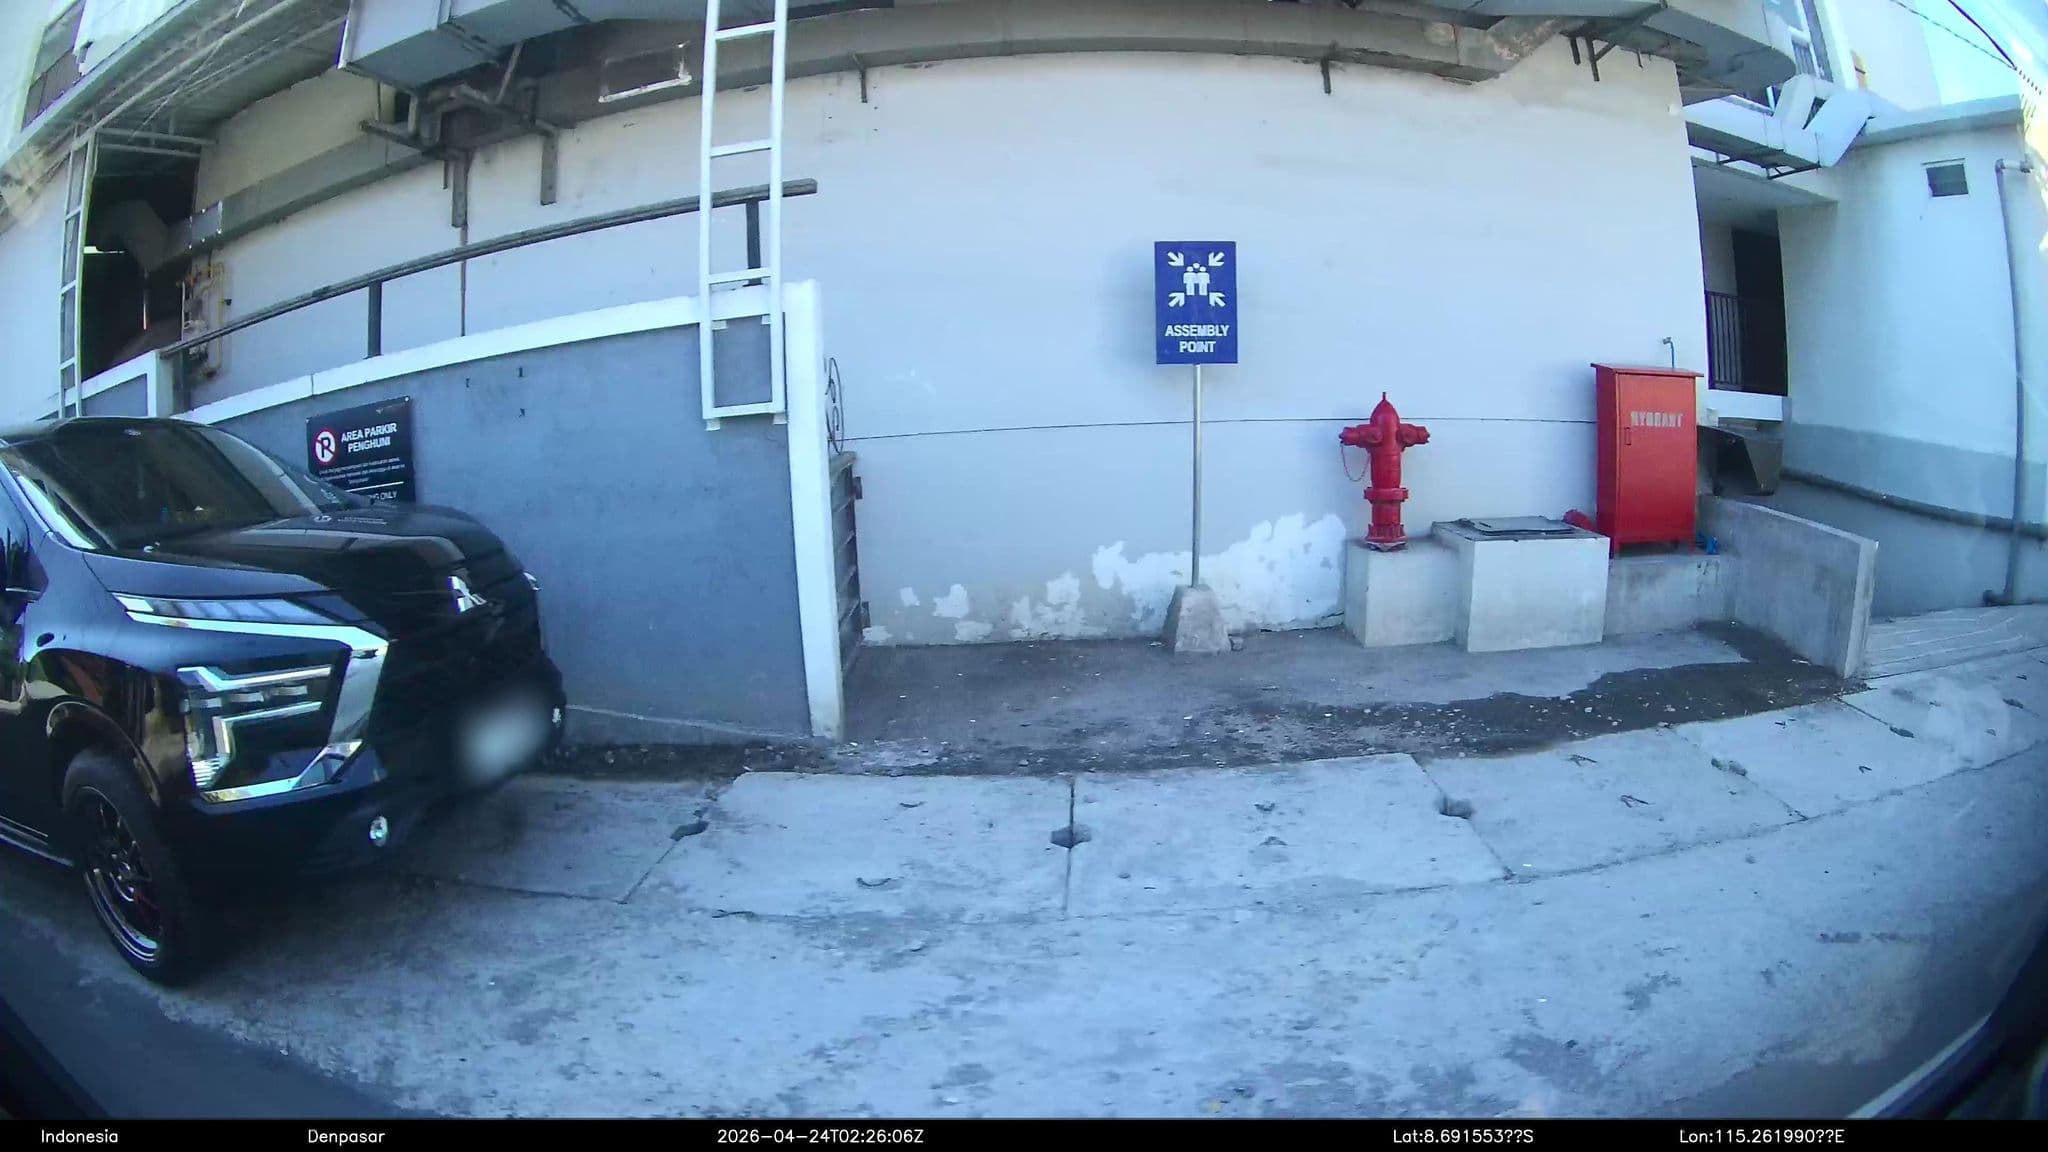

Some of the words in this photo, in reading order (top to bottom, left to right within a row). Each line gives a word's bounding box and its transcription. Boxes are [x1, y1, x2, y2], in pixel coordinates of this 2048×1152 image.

[1165, 324, 1230, 337] ASSEMBLY
[1179, 340, 1216, 353] POINT
[1631, 411, 1683, 427] HYDRANT
[341, 429, 363, 443] AREA
[364, 422, 397, 438] PARKIR
[347, 436, 391, 453] PENGHUNI
